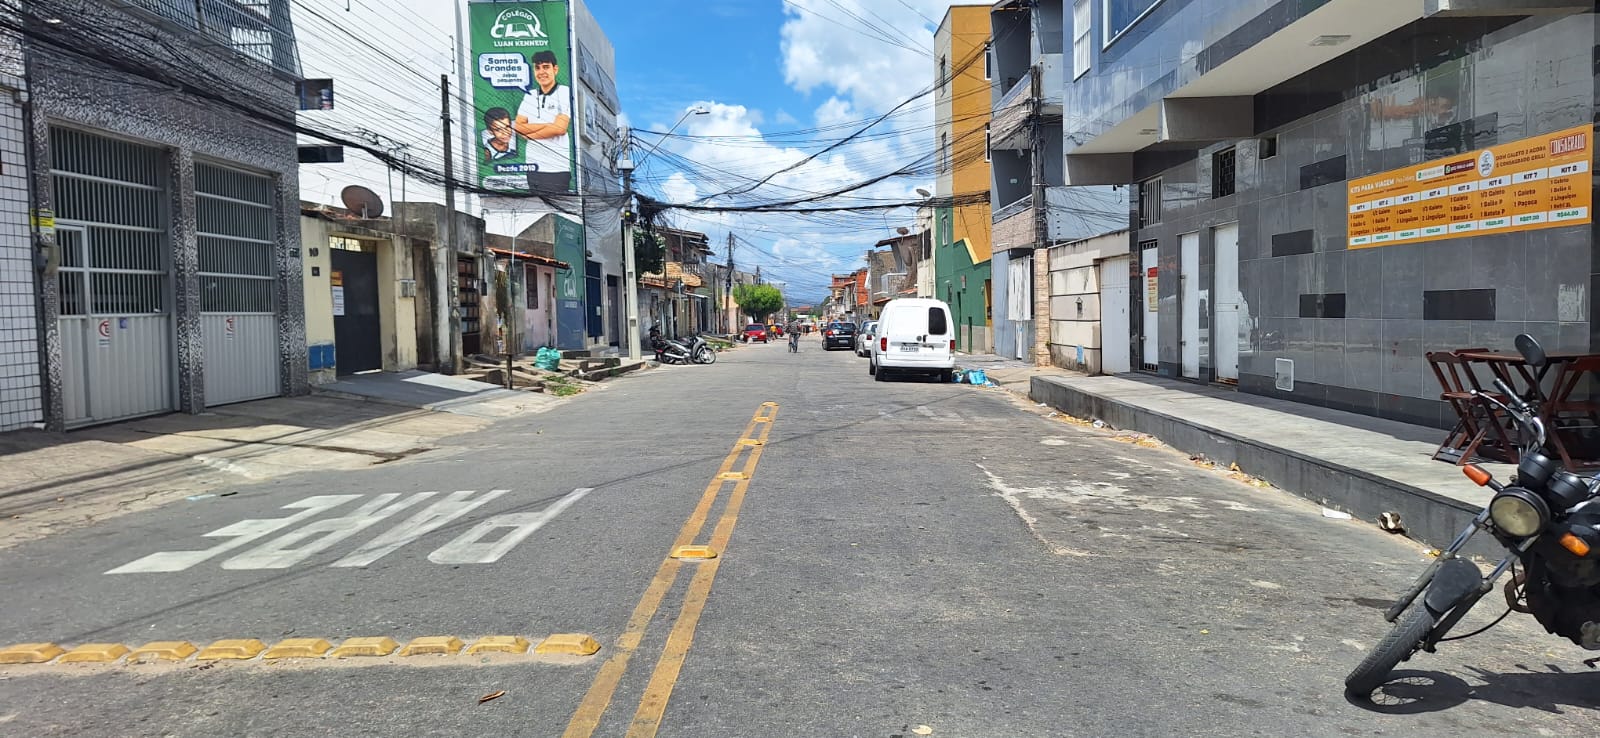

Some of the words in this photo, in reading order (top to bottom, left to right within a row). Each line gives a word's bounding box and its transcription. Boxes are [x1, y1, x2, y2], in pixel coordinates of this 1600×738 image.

[501, 10, 532, 21] COLÉGIO
[490, 23, 548, 39] CLK
[488, 57, 519, 65] Somos
[484, 64, 522, 72] Grandes
[1550, 133, 1585, 155] CONSAGRADO
[1496, 153, 1506, 161] DOM
[1507, 149, 1524, 158] GALETO
[1530, 145, 1546, 153] AGORA
[1501, 156, 1530, 166] CONSAGRADO
[1361, 182, 1373, 191] PARA
[1376, 177, 1394, 188] VIAGEM
[1489, 188, 1505, 196] Galeto
[1518, 188, 1536, 196] Galeto
[1554, 192, 1576, 201] Linguiças
[1518, 198, 1537, 208] Paçoca
[104, 488, 593, 575] PARE
